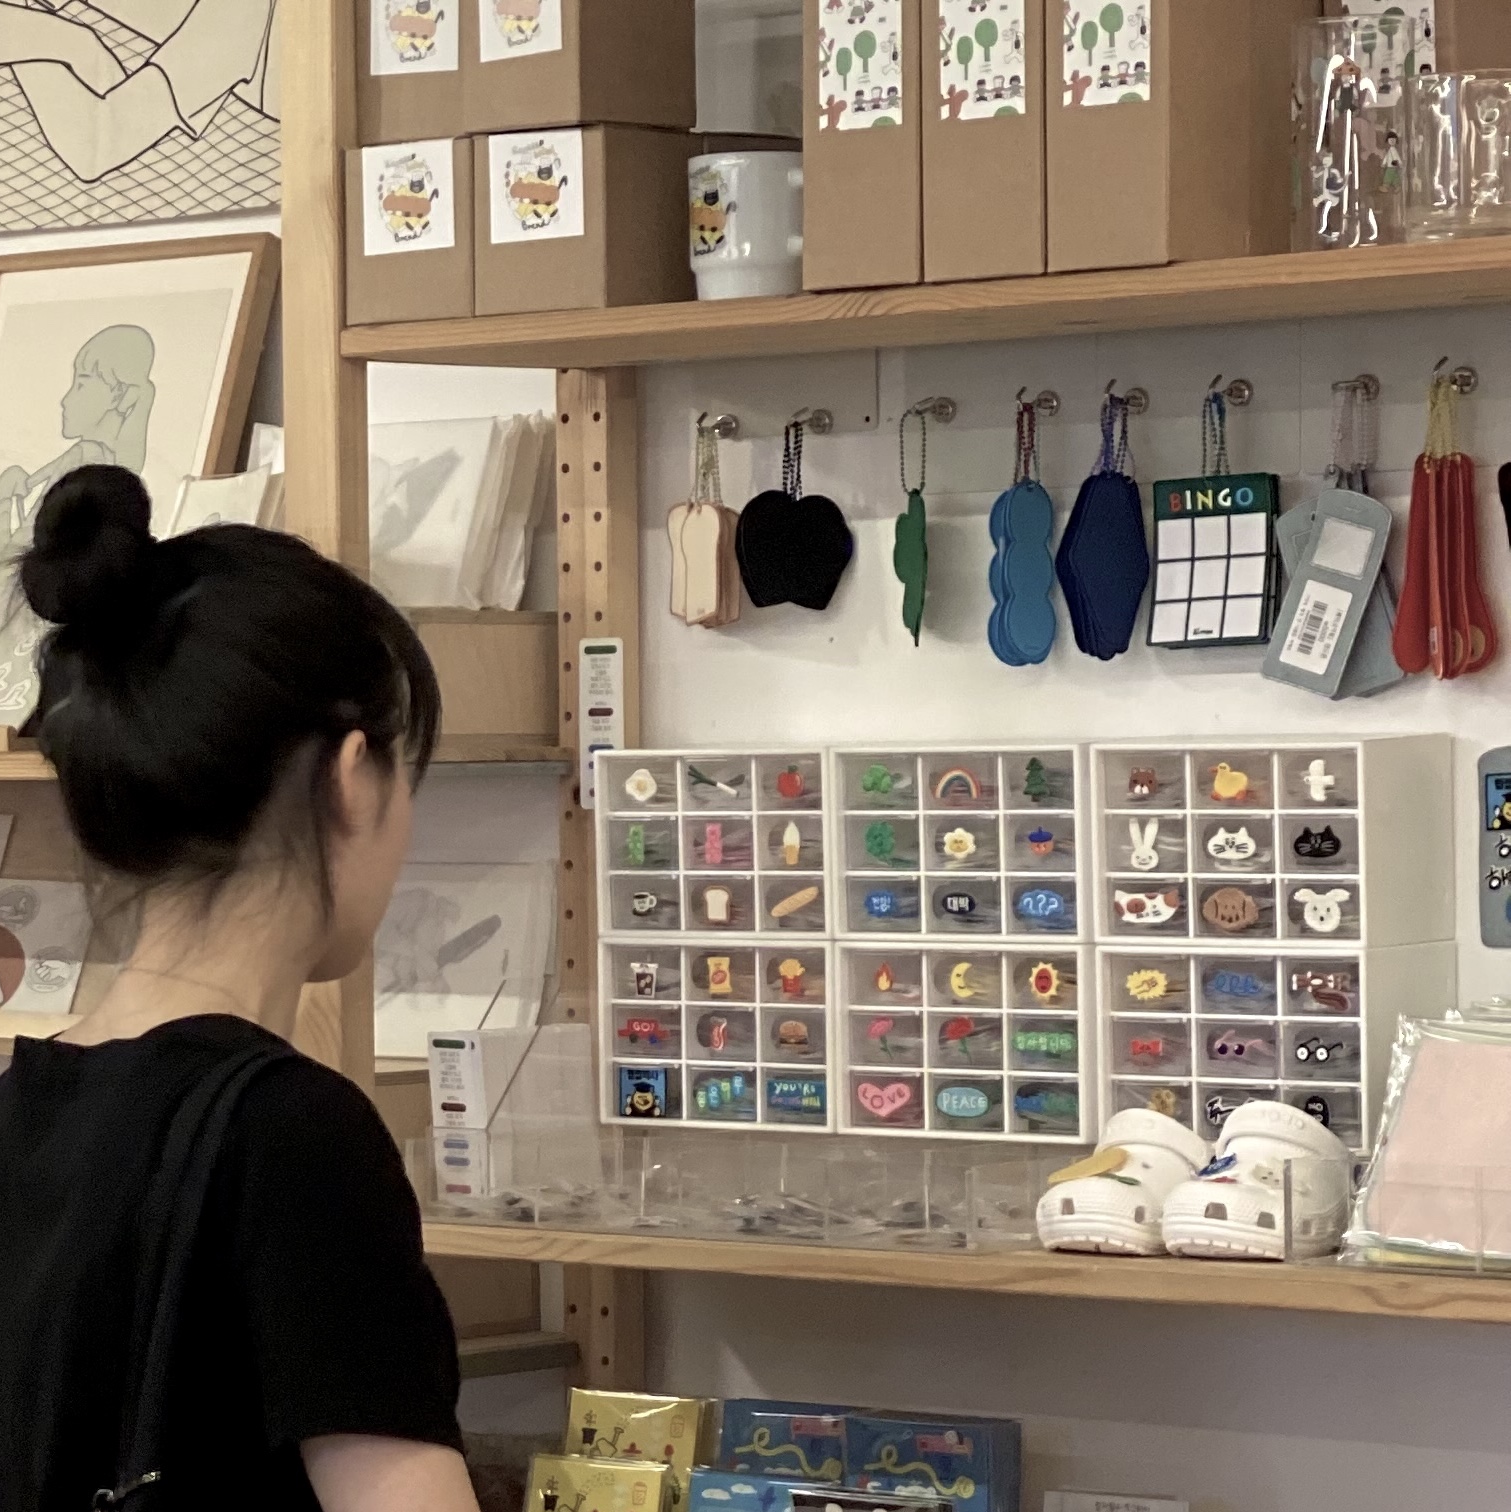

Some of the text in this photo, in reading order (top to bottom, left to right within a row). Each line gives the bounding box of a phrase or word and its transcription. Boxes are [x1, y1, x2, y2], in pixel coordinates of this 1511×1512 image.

[1168, 487, 1254, 512] BINGO
[861, 1085, 906, 1110] LOVE
[942, 1092, 987, 1110] PEACE
